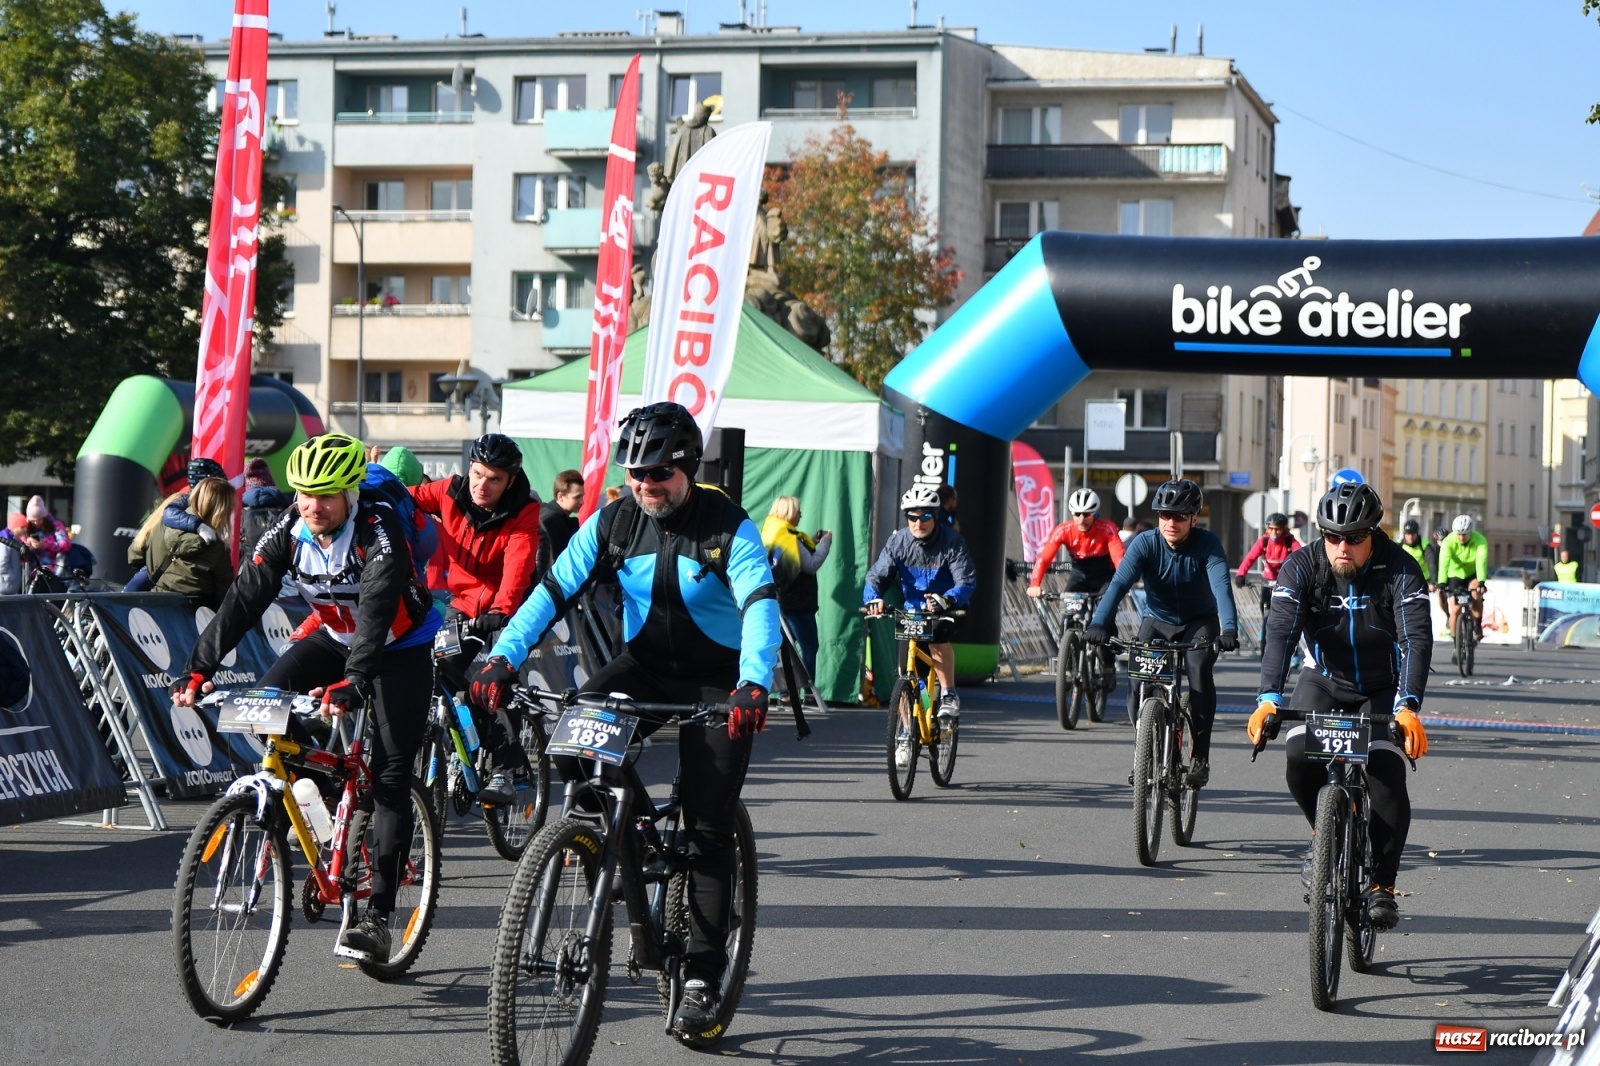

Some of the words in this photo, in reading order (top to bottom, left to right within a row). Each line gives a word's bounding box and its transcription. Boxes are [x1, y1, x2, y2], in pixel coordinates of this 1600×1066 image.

[1172, 283, 1283, 336] bike
[1298, 288, 1472, 339] atelier
[1541, 590, 1564, 600] RACE
[903, 625, 924, 635] 253
[1139, 662, 1163, 675] 257
[233, 698, 282, 706] OPIEKUN
[234, 705, 272, 722] 266
[567, 718, 621, 736] OPIEKUN
[1314, 728, 1360, 739] OPIEKUN
[567, 727, 609, 748] 189
[1322, 738, 1353, 754] 191
[184, 769, 233, 787] KOKOwear
